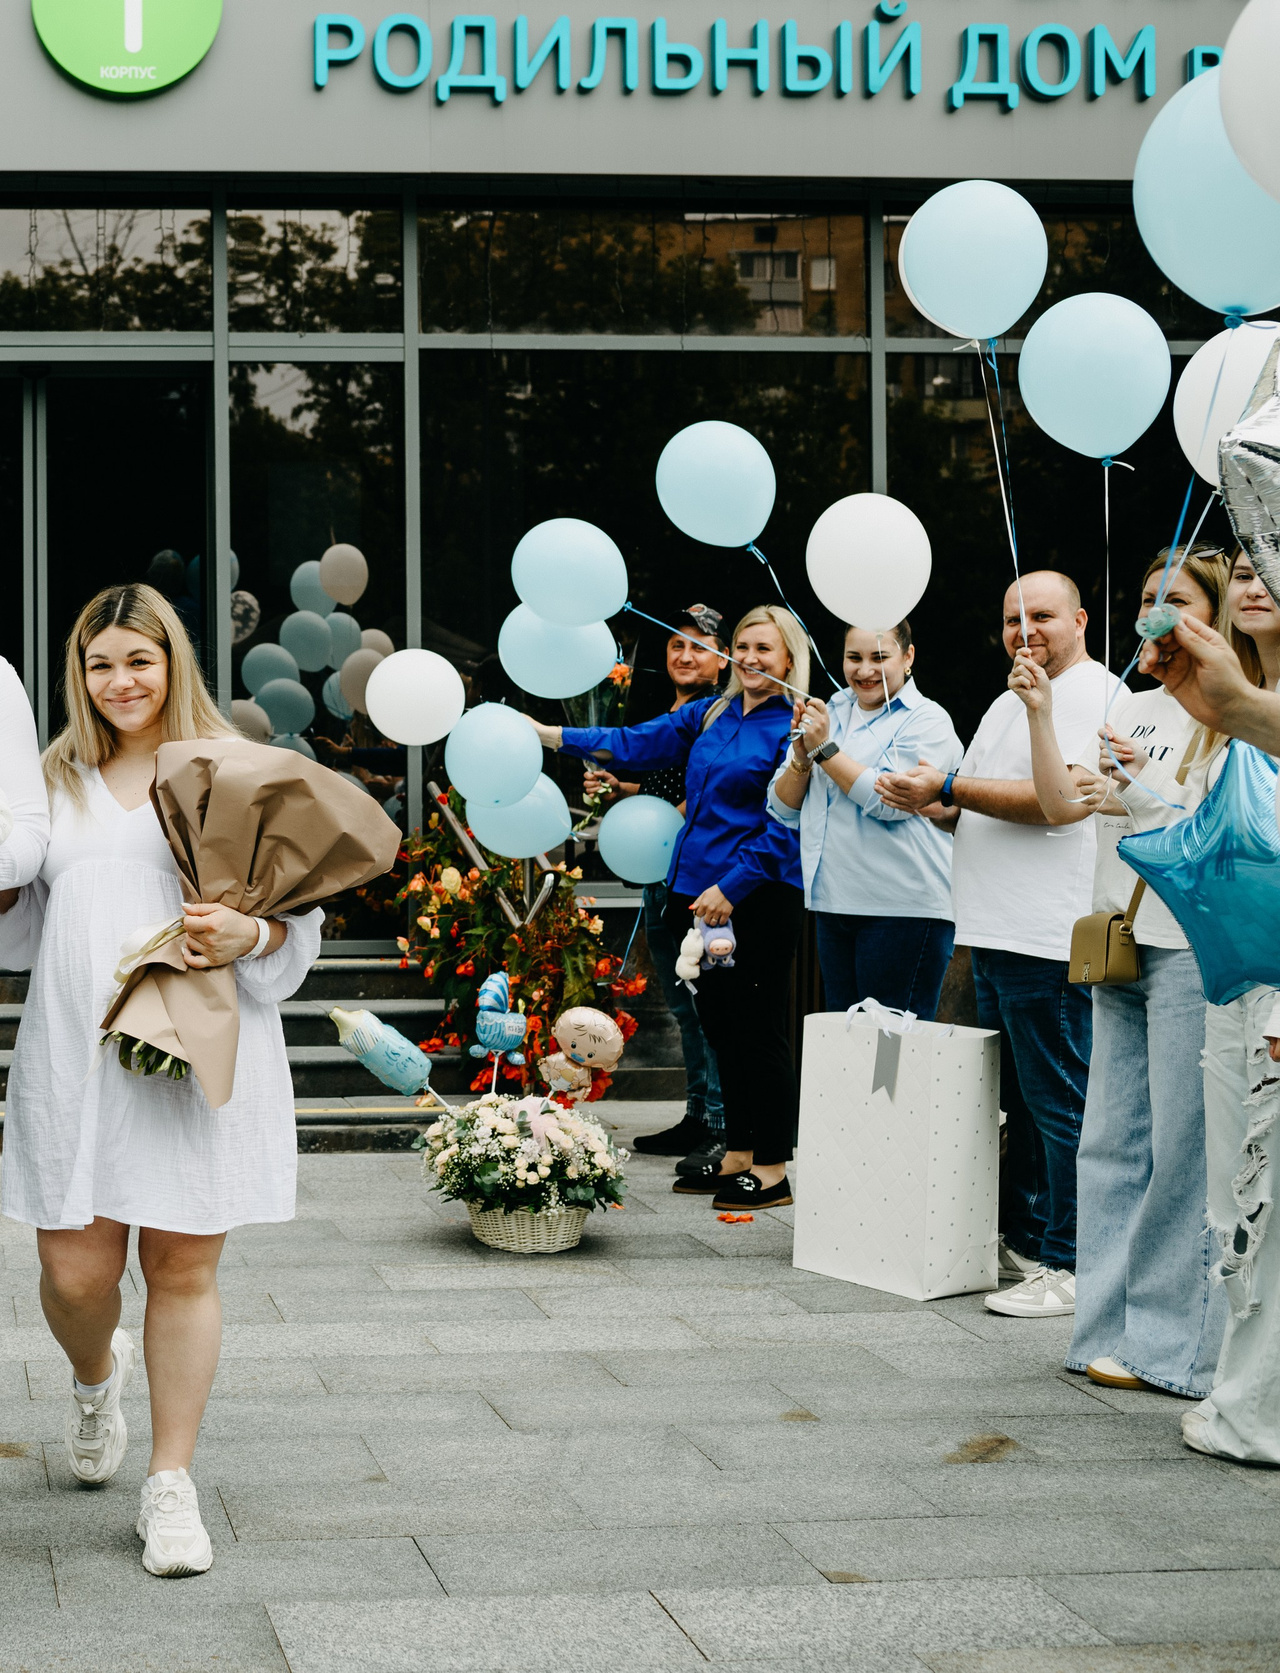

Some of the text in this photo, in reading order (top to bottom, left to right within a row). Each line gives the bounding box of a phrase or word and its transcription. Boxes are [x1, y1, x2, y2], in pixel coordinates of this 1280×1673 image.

[314, 0, 1157, 109] РОДИЛЬНЫЙ ДОМ
[100, 66, 157, 79] КОРПУС
[1130, 725, 1156, 739] DO
